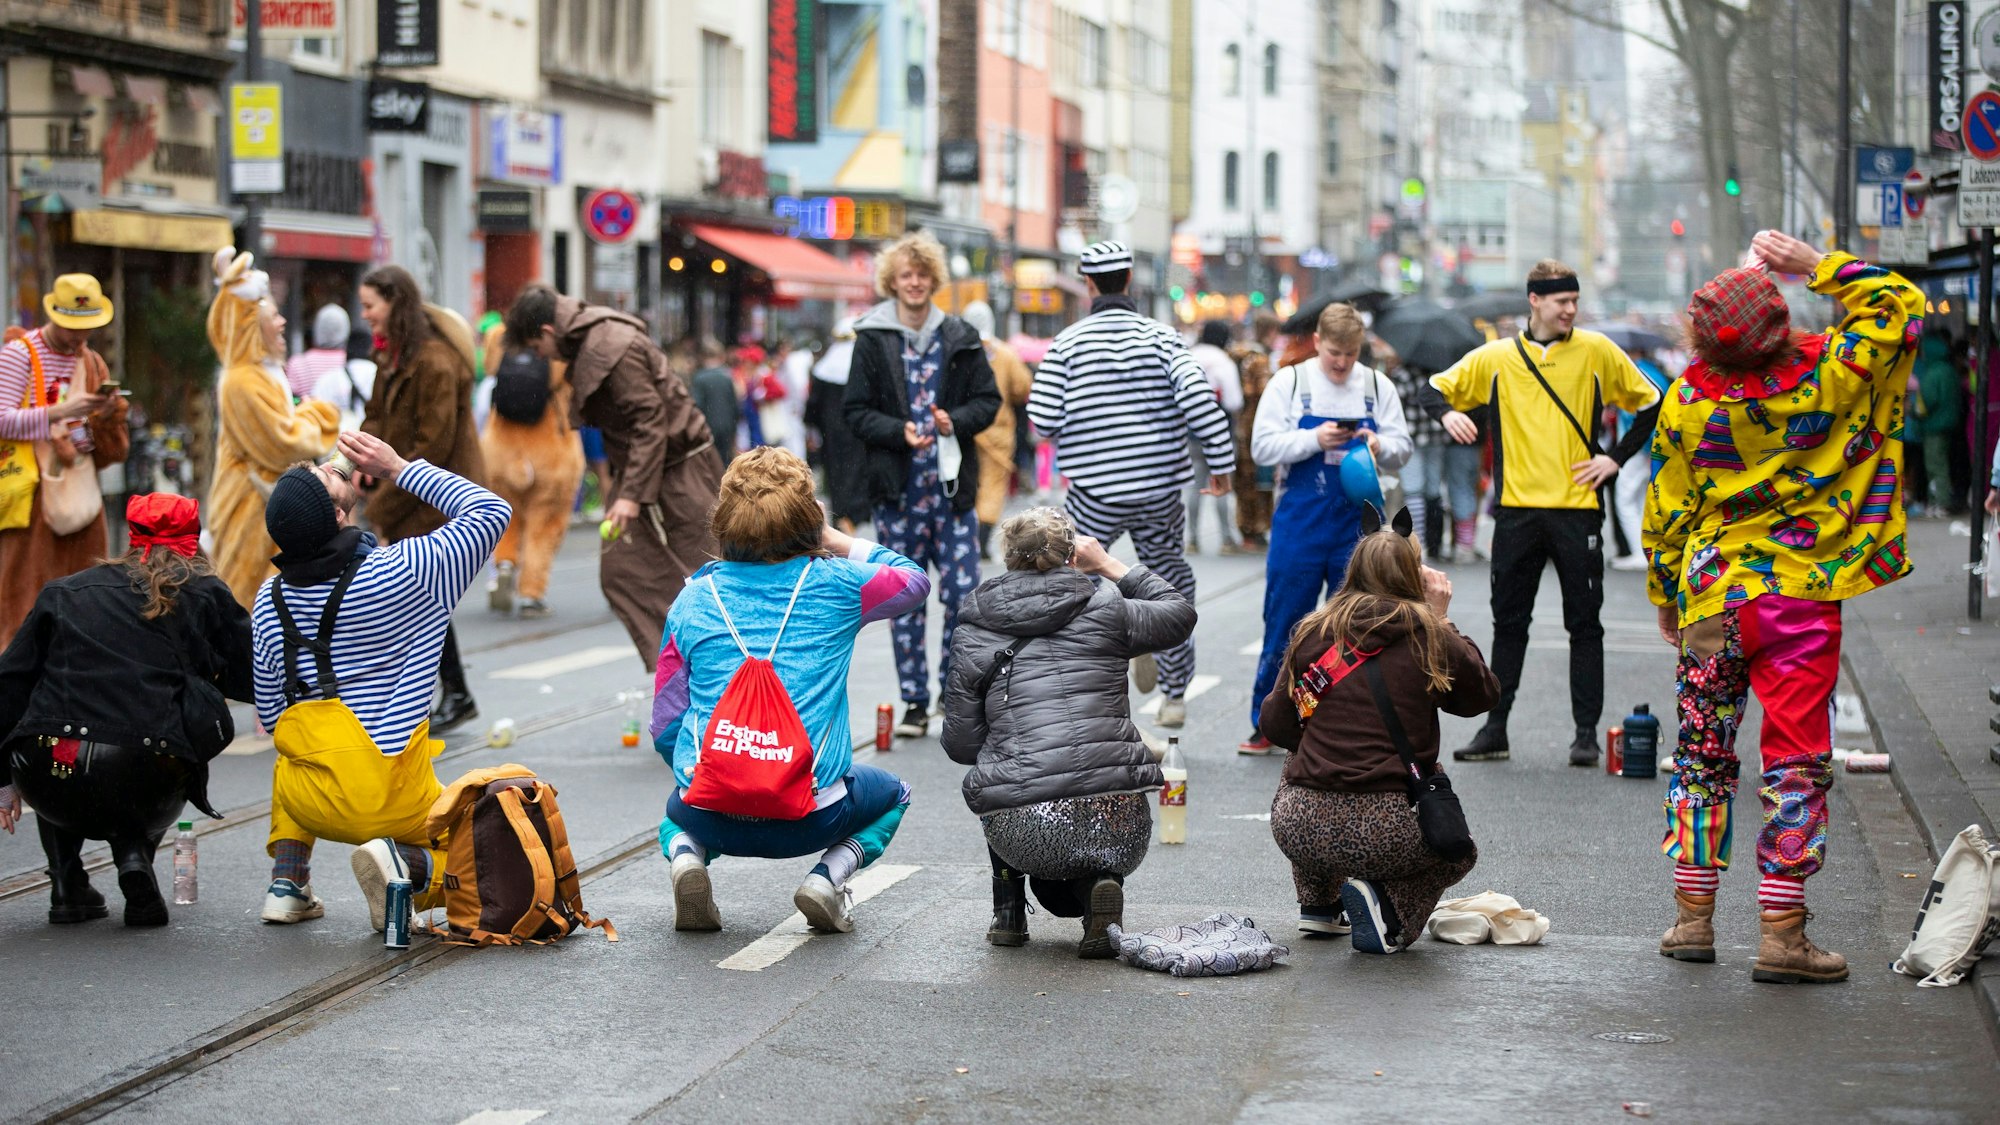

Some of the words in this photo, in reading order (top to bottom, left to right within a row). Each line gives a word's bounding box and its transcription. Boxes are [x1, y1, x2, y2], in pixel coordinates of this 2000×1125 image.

[371, 88, 425, 125] sky
[715, 719, 779, 746] Erstmal
[711, 737, 735, 753] zu
[734, 739, 794, 763] Penny
